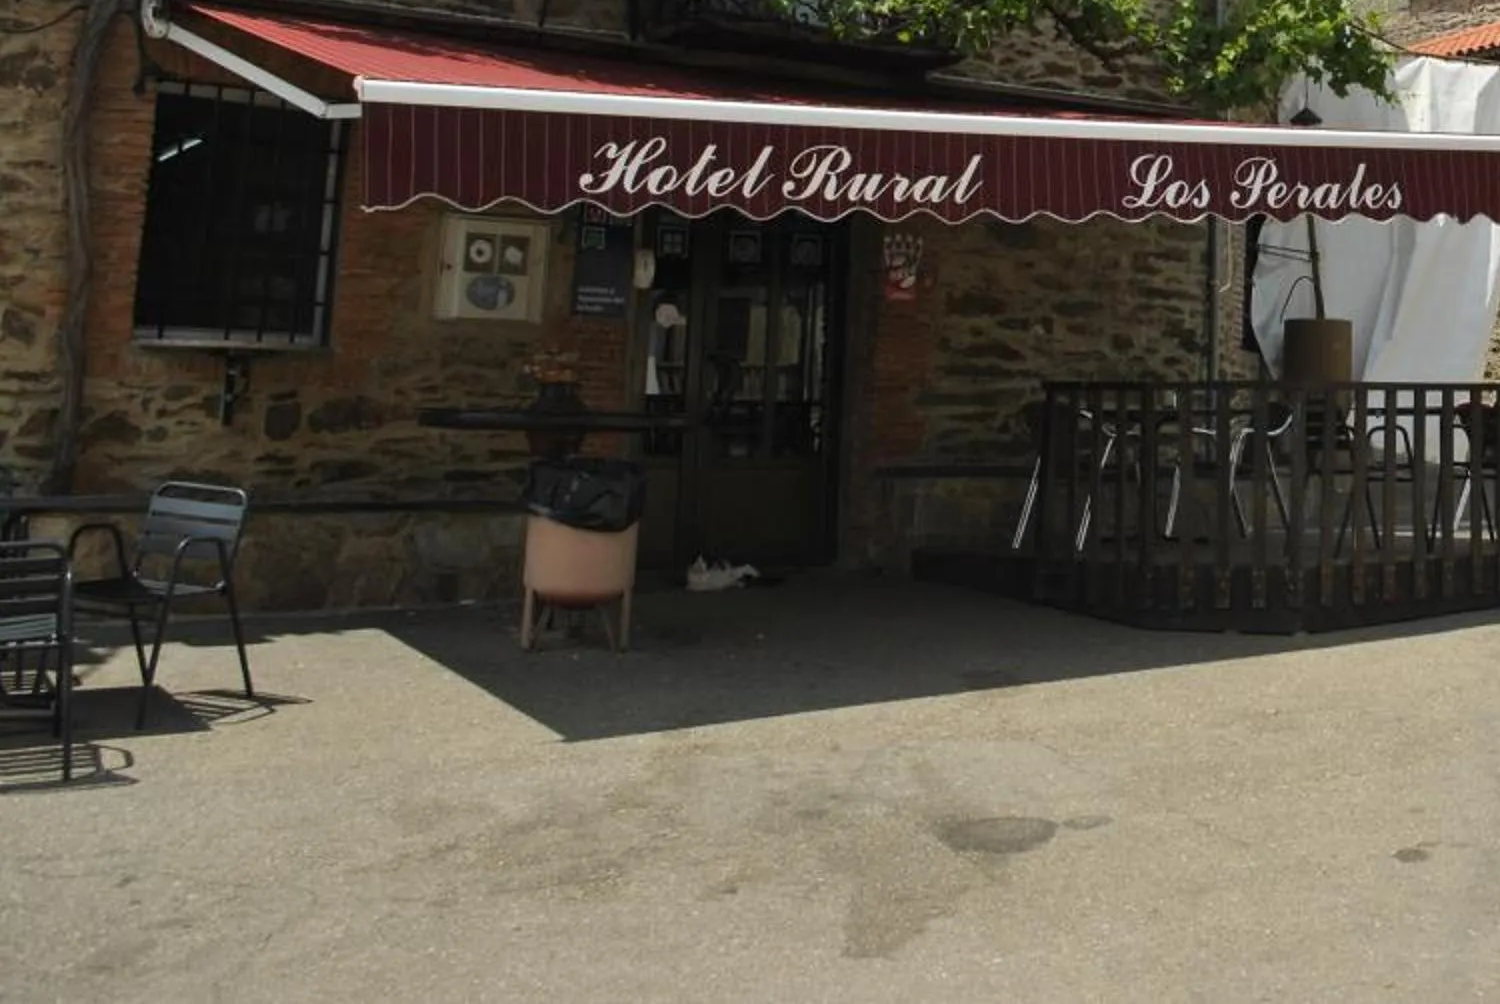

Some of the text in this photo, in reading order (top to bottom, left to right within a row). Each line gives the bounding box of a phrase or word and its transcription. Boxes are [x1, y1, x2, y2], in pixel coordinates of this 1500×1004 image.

[578, 137, 1402, 211] Hotel Rural Los Perales
